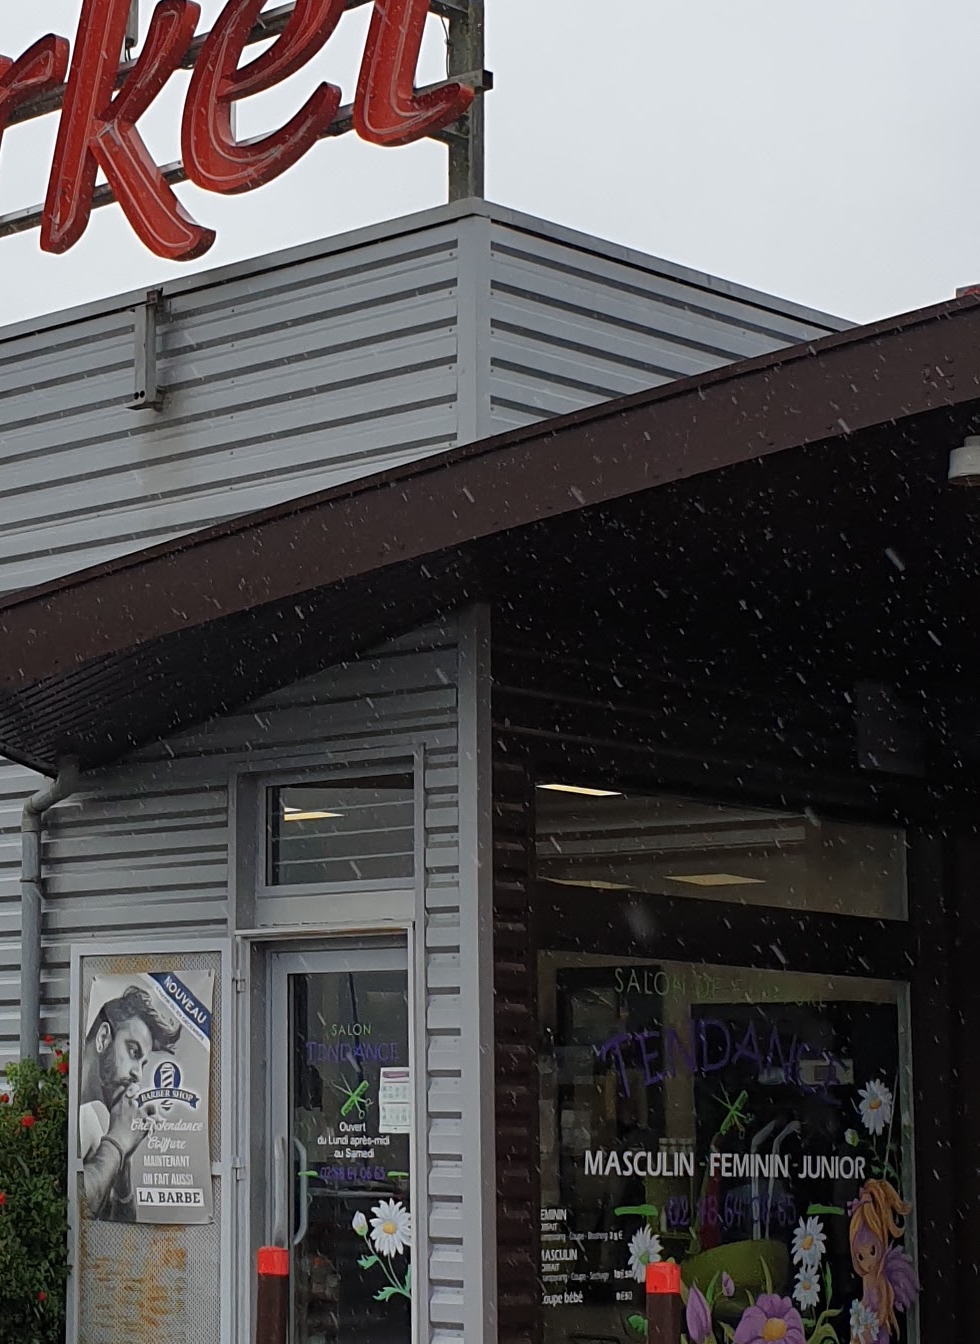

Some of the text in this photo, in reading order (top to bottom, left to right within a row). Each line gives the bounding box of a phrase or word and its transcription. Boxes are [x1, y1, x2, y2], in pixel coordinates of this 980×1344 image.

[611, 967, 687, 1000] SALON
[163, 975, 208, 1024] NOUVEAU
[331, 1023, 372, 1036] SALON
[306, 1041, 400, 1065] TENDANCE
[140, 1088, 195, 1102] BARBER SHOP
[339, 1121, 367, 1133] Ouvert
[147, 1136, 187, 1153] Coiffure
[317, 1135, 391, 1149] du Lundi après-midi
[333, 1147, 375, 1158] au Samedi
[143, 1155, 190, 1168] MAINTENANT
[584, 1150, 867, 1181] MASCULIN FEMININ JUNIOR
[143, 1173, 194, 1186] ON FAIT AUSSI
[139, 1192, 201, 1204] LA BARBE
[540, 1208, 567, 1221] EMININ
[563, 1290, 584, 1304] bébé
